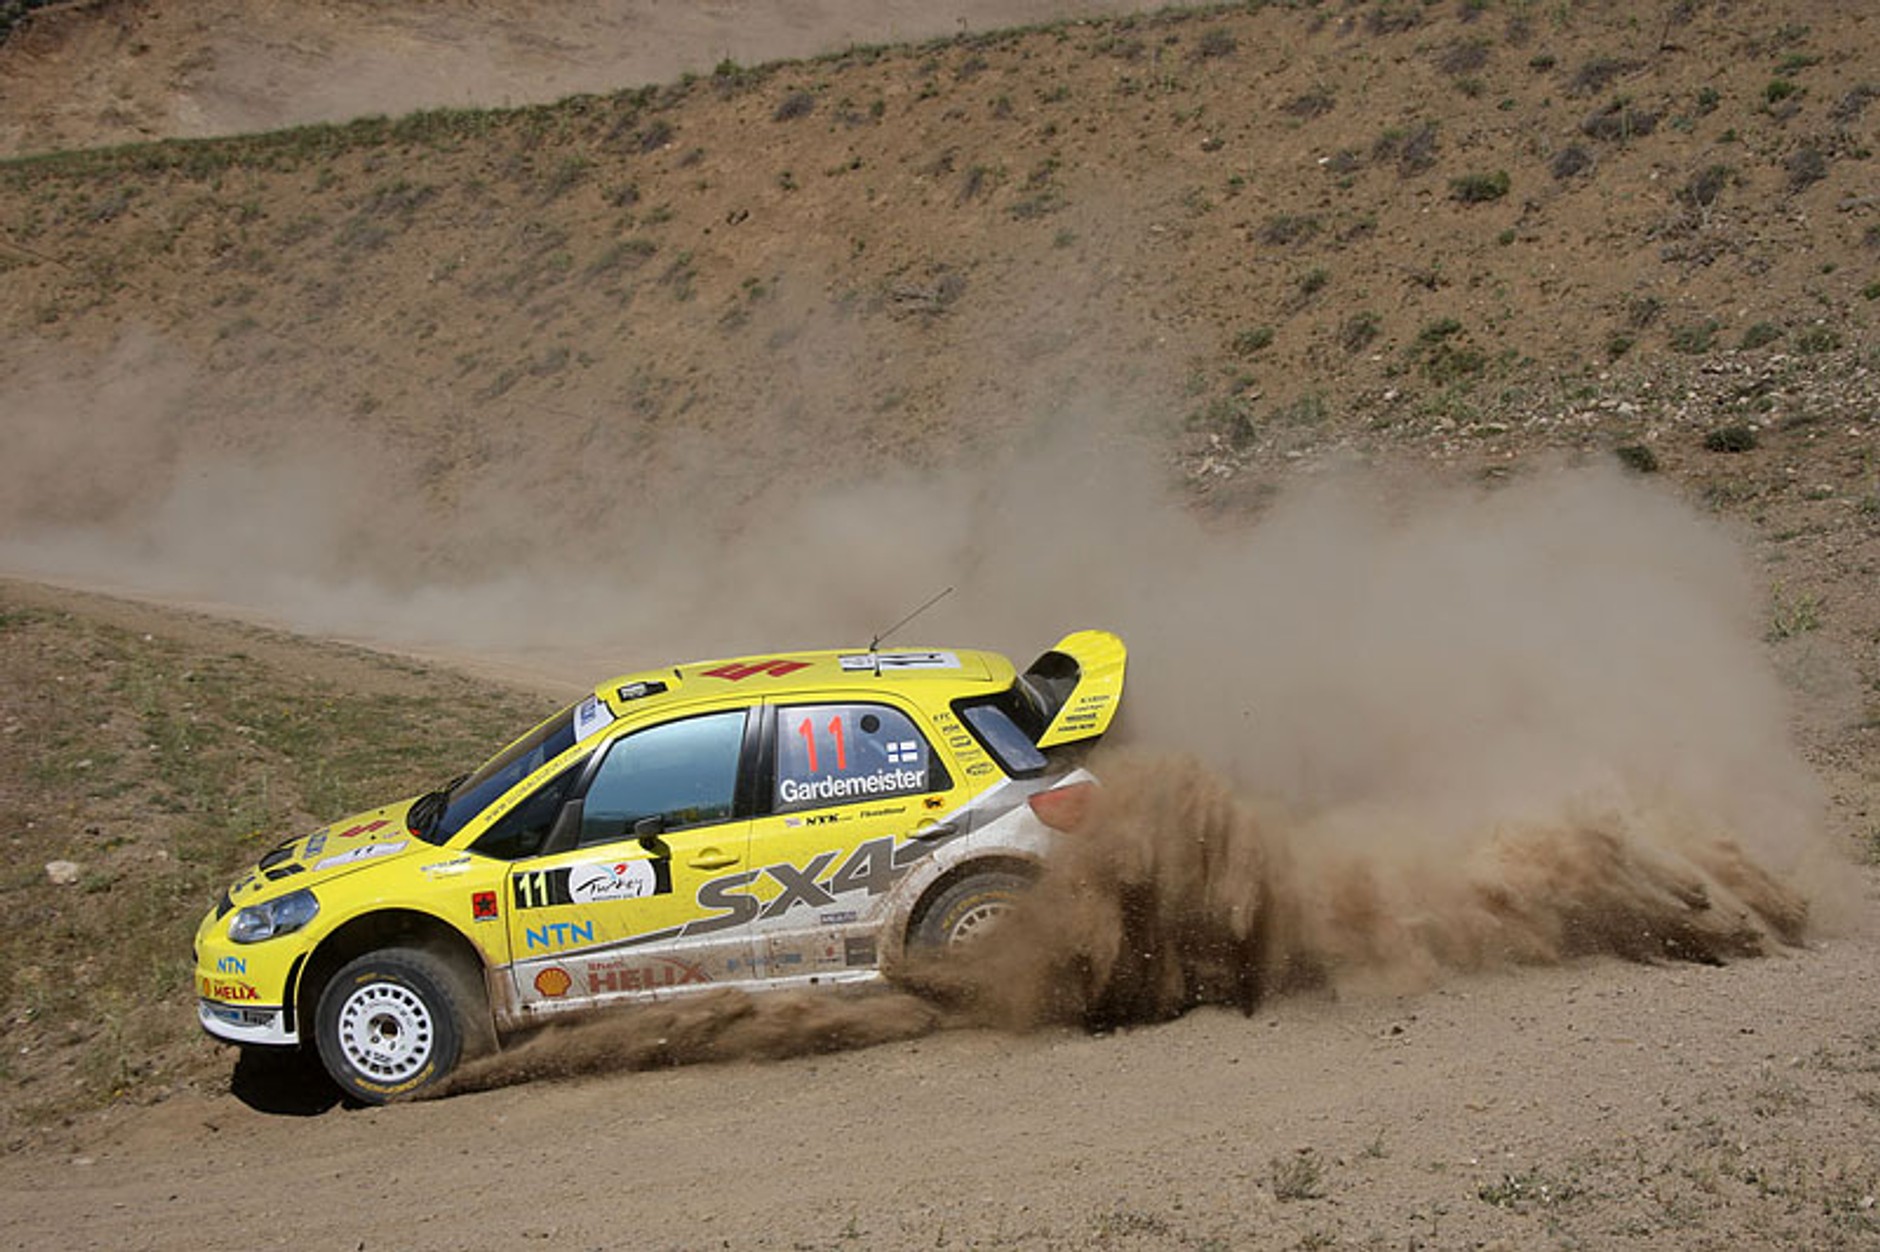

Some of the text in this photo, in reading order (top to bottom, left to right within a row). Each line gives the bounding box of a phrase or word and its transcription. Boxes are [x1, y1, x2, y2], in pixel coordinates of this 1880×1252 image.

[798, 714, 847, 773] 11
[780, 769, 925, 802] Gardemeister
[519, 871, 548, 908] 11
[576, 875, 644, 897] Turkey
[678, 836, 897, 933] SX4
[526, 920, 594, 949] NTN
[217, 956, 246, 975] NTN
[588, 963, 706, 993] HELIX
[214, 986, 260, 1000] HELIX
